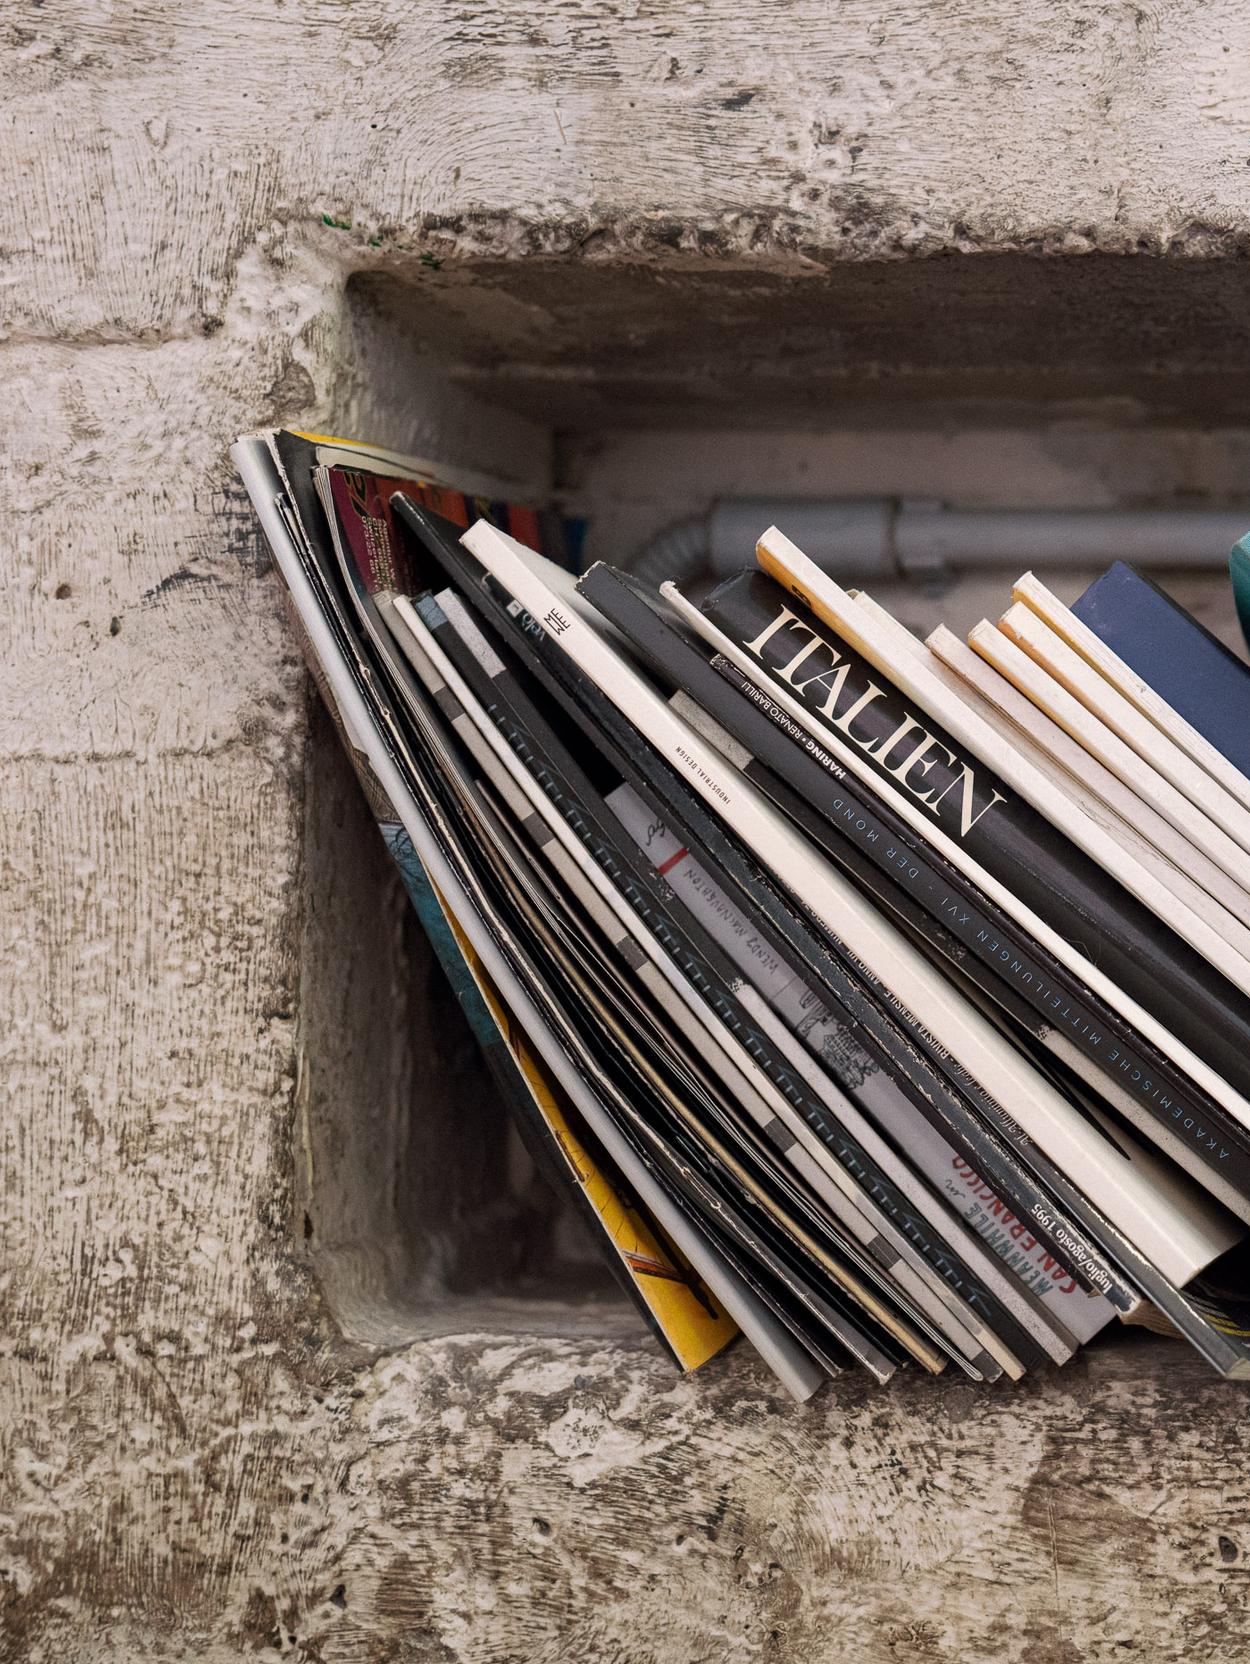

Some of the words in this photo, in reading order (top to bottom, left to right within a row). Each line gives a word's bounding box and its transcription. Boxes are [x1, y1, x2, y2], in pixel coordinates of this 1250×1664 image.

[740, 680, 772, 710] BARILLI
[742, 603, 1007, 836] ITALIEN
[768, 706, 803, 739] RENATO
[674, 745, 698, 770] DESIGN
[804, 739, 847, 779] HARING
[696, 766, 731, 805] INDUSTRIAL
[833, 799, 878, 841] MOND
[885, 846, 920, 879] DER
[940, 896, 970, 925] XVI
[976, 930, 1101, 1044] MITTEILUNGEN
[1108, 1049, 1229, 1158] AKADEMISCHE
[1030, 1202, 1057, 1231] 1995
[962, 1201, 1054, 1300] MEANWHILE
[1055, 1228, 1112, 1293] luglio/agosto
[1033, 1249, 1079, 1297] SAN
